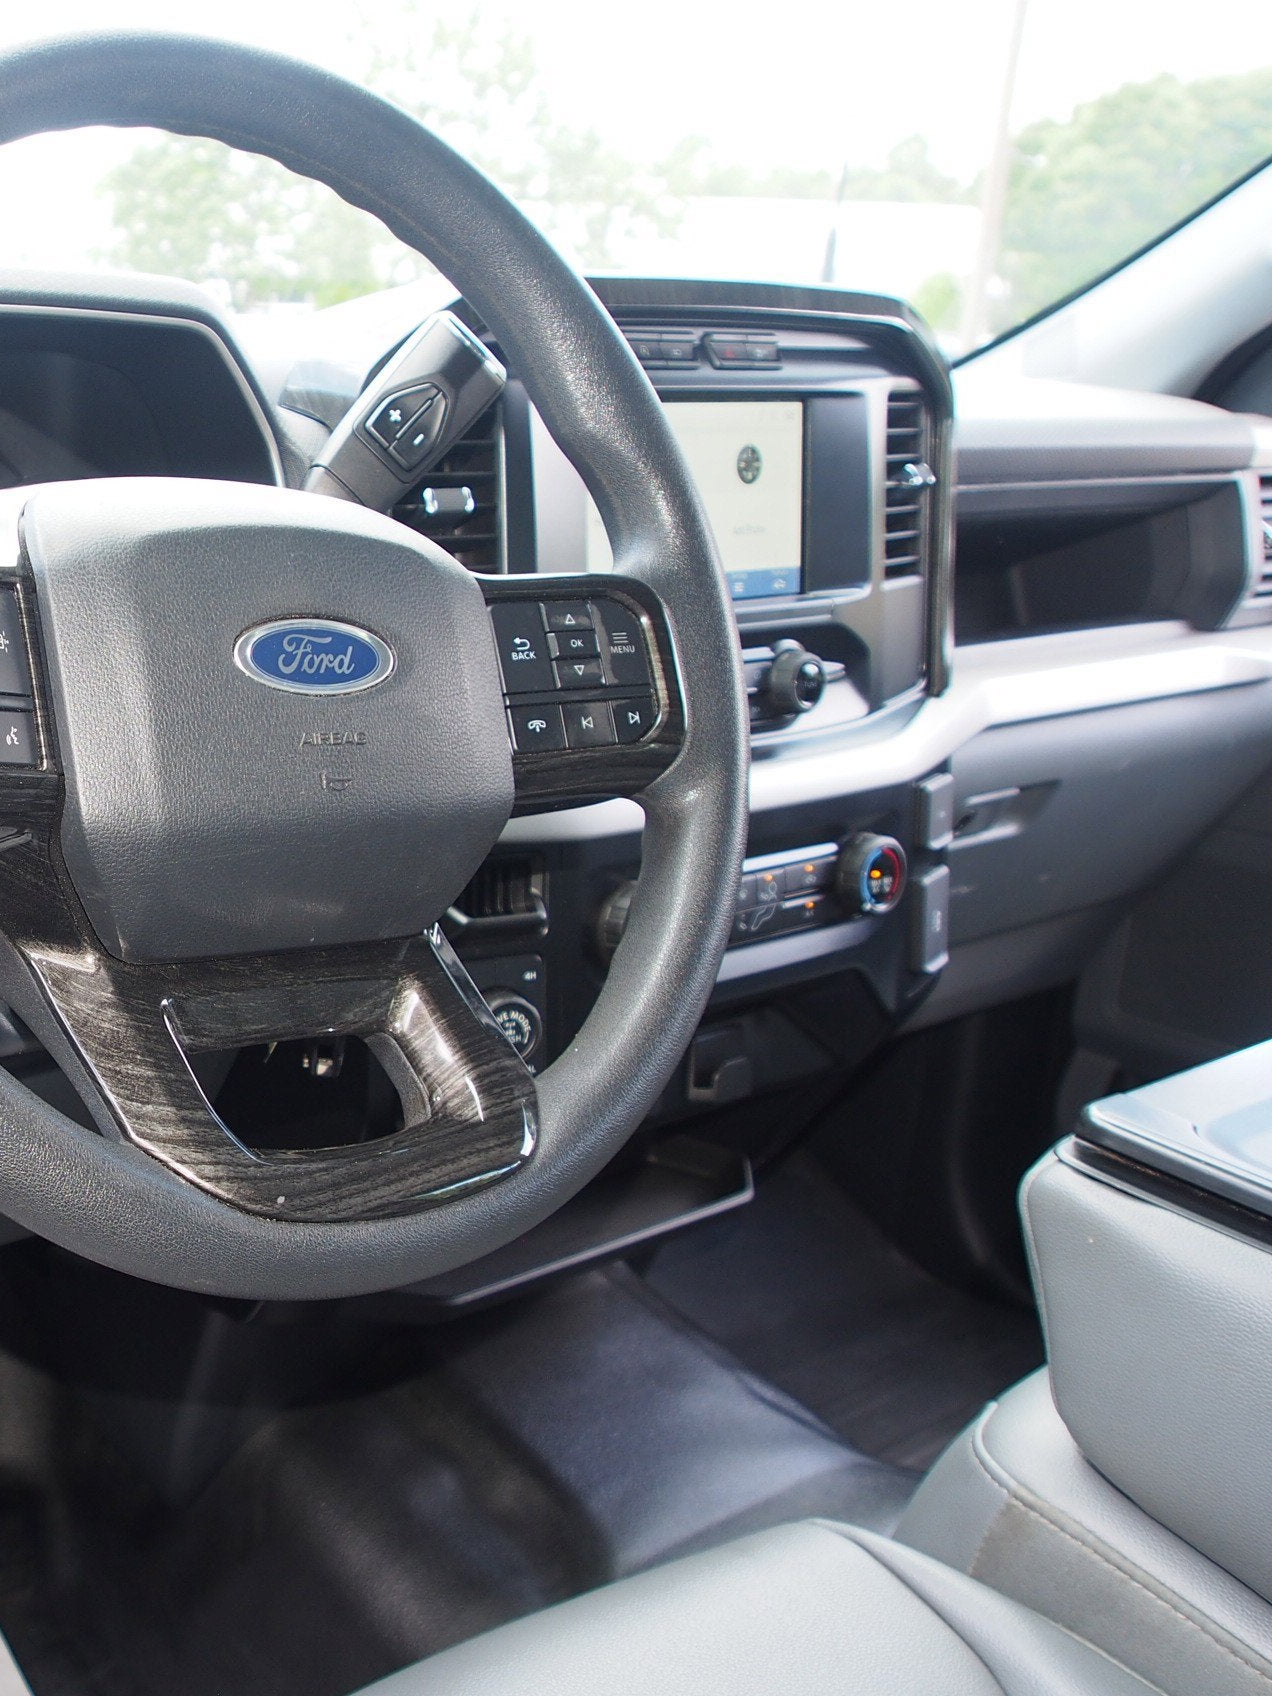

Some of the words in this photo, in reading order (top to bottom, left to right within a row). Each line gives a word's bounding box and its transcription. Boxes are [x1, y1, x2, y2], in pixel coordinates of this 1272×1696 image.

[570, 639, 583, 647] OK
[610, 645, 635, 653] MENU
[278, 633, 355, 675] Ford
[511, 651, 537, 661] BACK
[299, 731, 367, 747] AIRBAG
[509, 1010, 532, 1031] MODE
